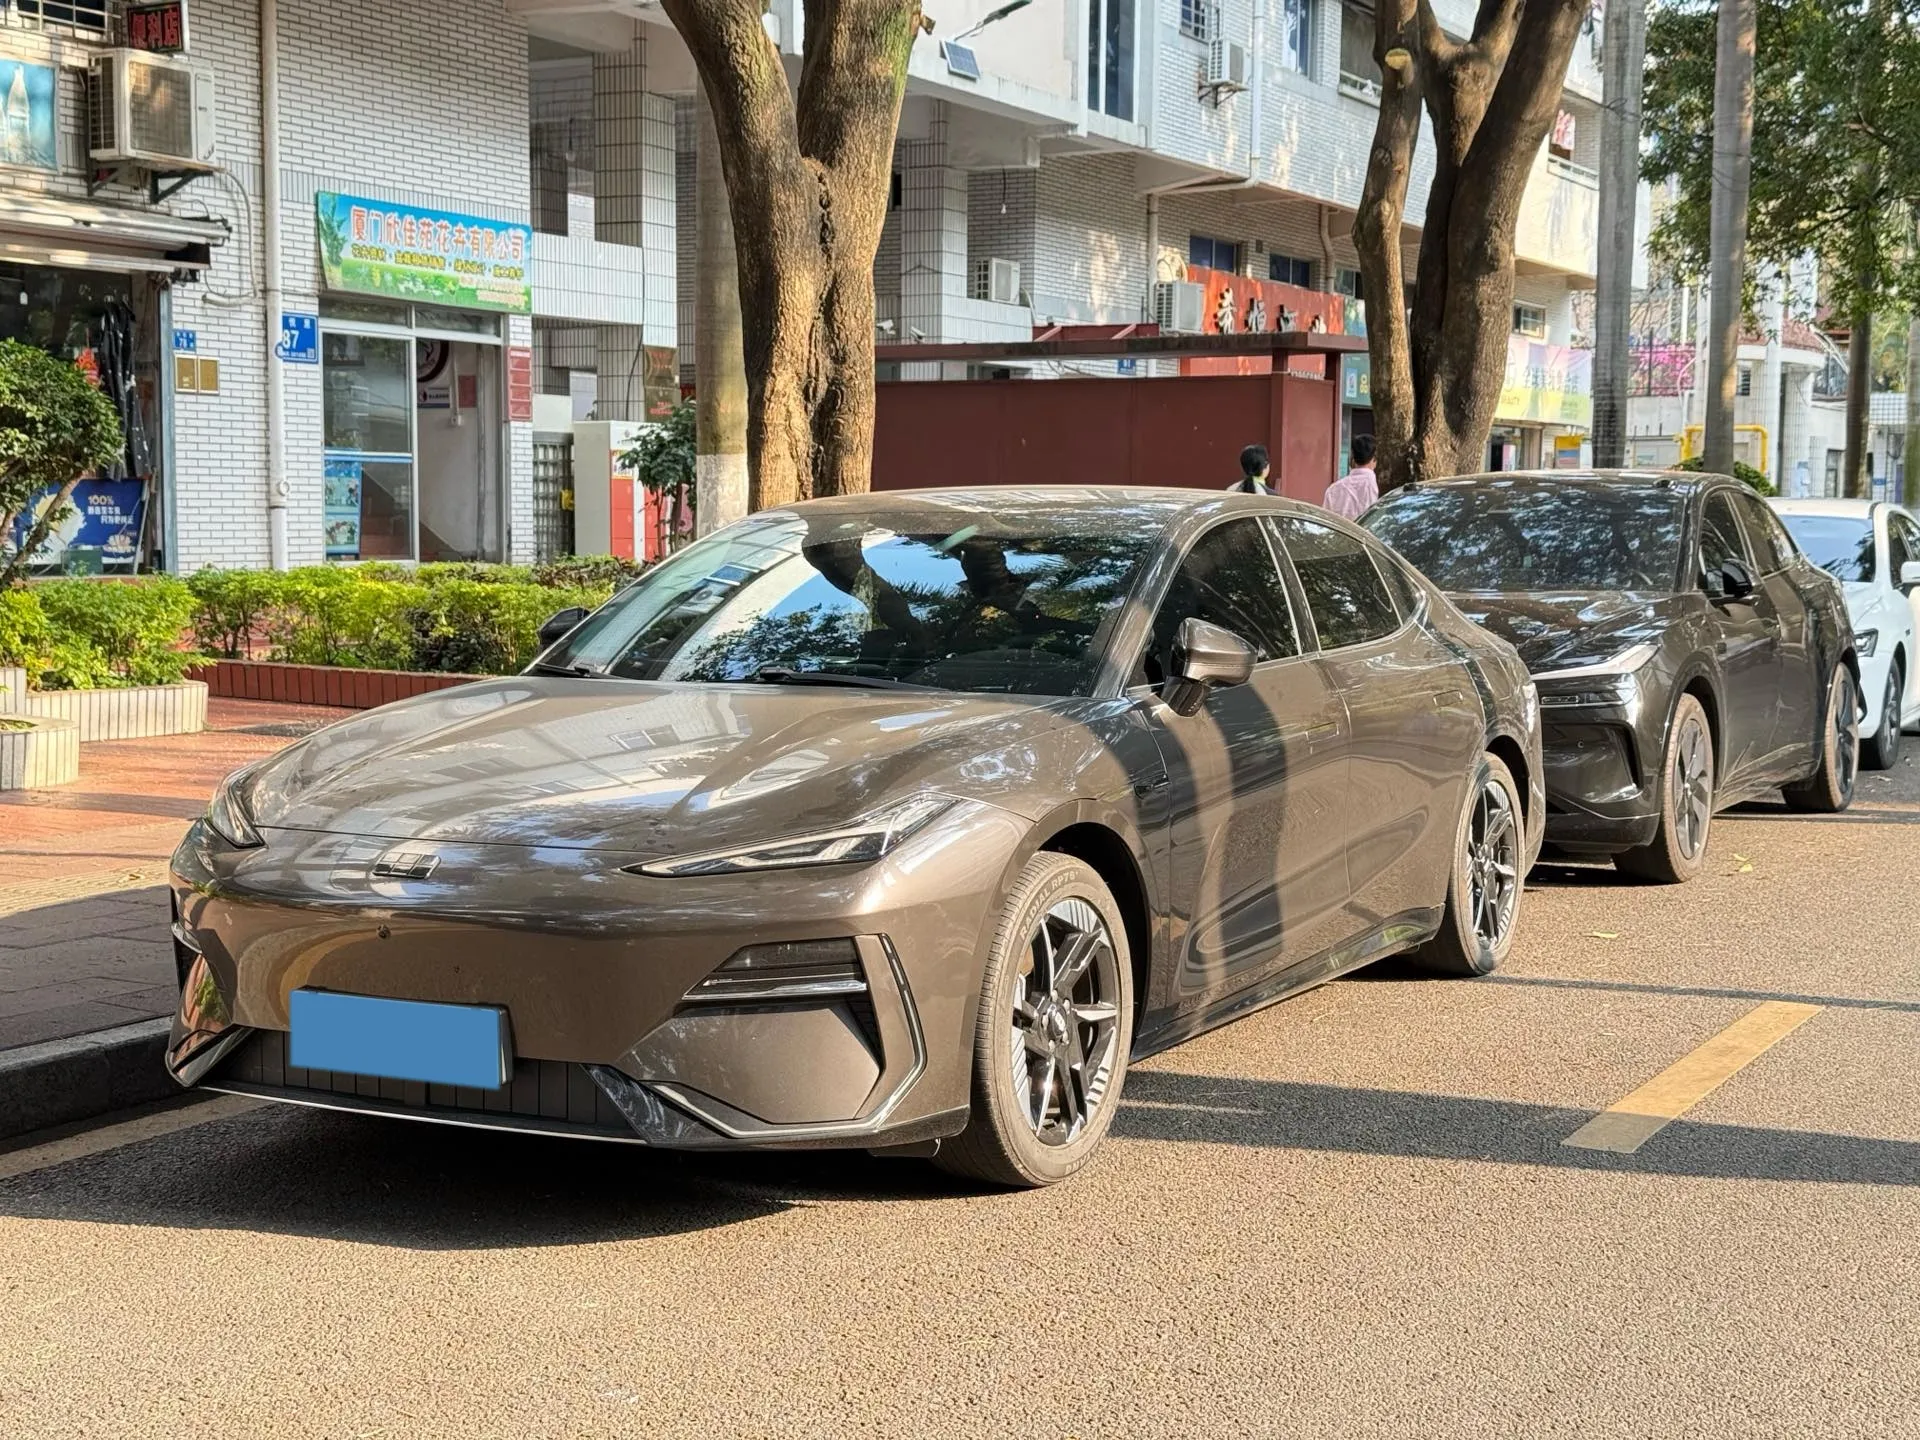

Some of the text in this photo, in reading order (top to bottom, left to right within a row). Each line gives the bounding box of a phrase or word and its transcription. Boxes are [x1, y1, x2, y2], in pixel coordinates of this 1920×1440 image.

[351, 205, 524, 260] 厦门欣佳苑花卉有限公司
[282, 329, 299, 349] 87
[88, 495, 114, 506] 100%
[1020, 888, 1051, 940] RADIAL
